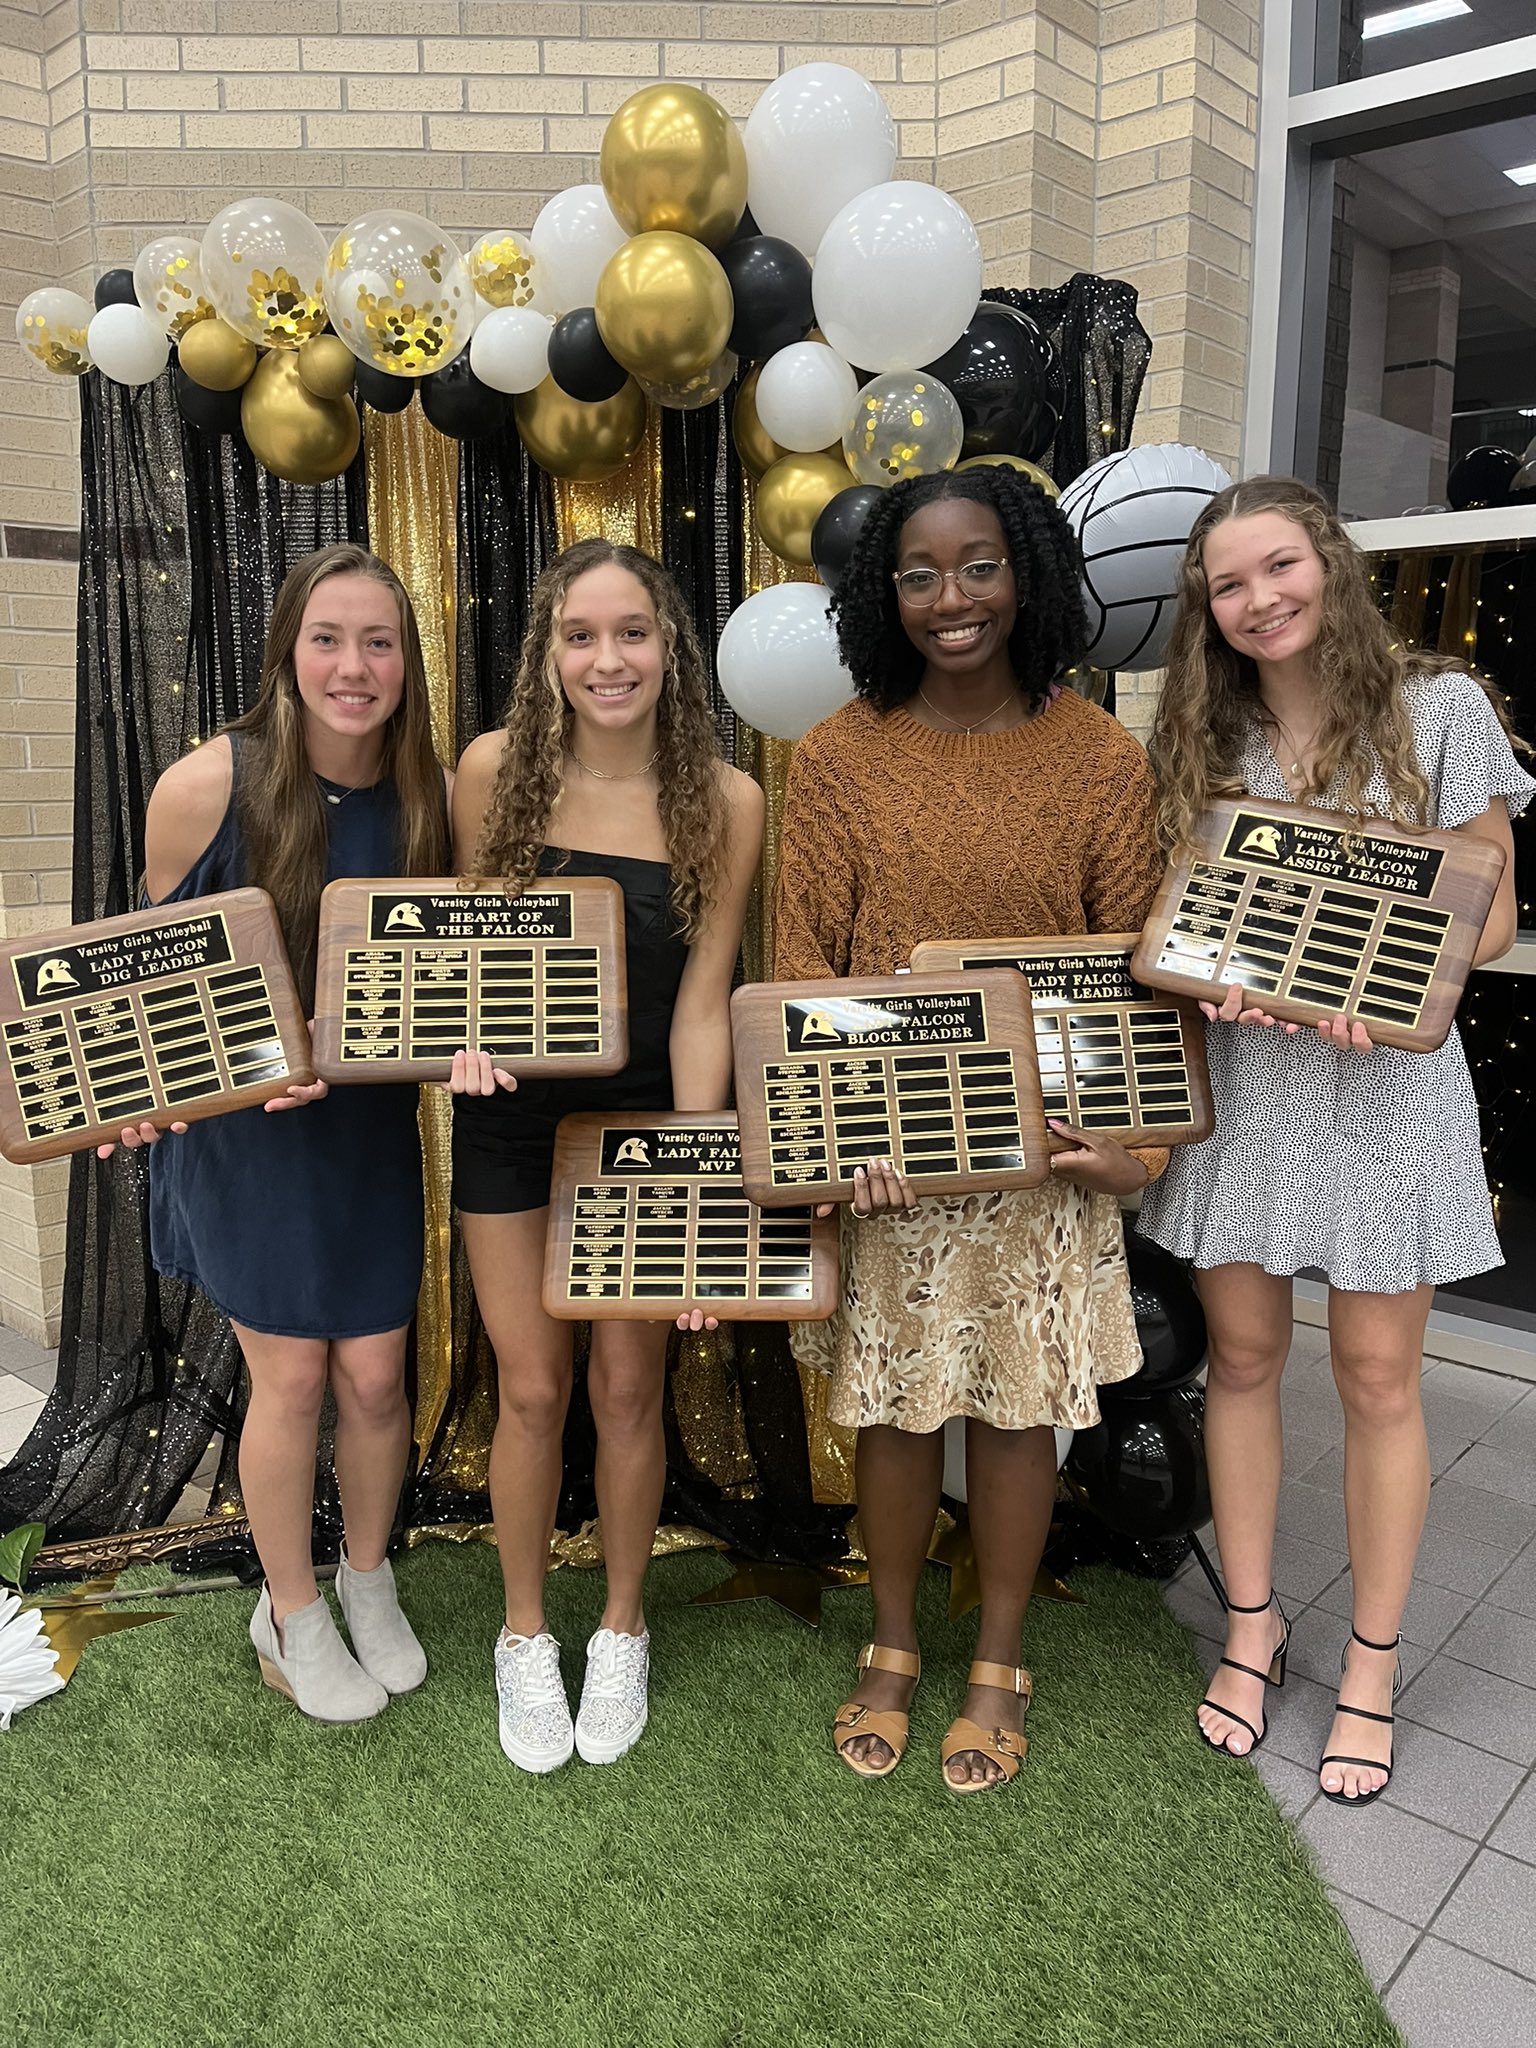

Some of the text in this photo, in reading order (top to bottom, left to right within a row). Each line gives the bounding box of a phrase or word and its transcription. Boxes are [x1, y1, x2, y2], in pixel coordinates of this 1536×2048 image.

[1294, 826, 1430, 862] Varsity Grls Volleyball
[1294, 843, 1418, 876] LADY FALCON
[1283, 855, 1418, 891] ASSIST LEADER
[430, 896, 560, 910] Varsity Girls Volleyball
[450, 912, 543, 924] HEART OF
[436, 924, 554, 936] THE FALCON
[77, 920, 212, 959] Varsity Girls Volleyball
[90, 937, 209, 974] LADY FALCON
[100, 952, 206, 986] DIG LEADER
[1018, 957, 1130, 972] Varsity Girls Volleyba
[1027, 972, 1132, 988] LADY FALCON
[1030, 986, 1134, 1000] KILL LEADER
[886, 999, 912, 1012] Girls
[916, 996, 970, 1010] Volleyball
[900, 1013, 966, 1027] FALCON
[848, 1027, 974, 1045] BLOCK LEADER
[657, 1132, 694, 1144] Varsity
[698, 1132, 724, 1142] Girls
[657, 1148, 742, 1158] LADY FAL
[698, 1160, 736, 1171] MVP
